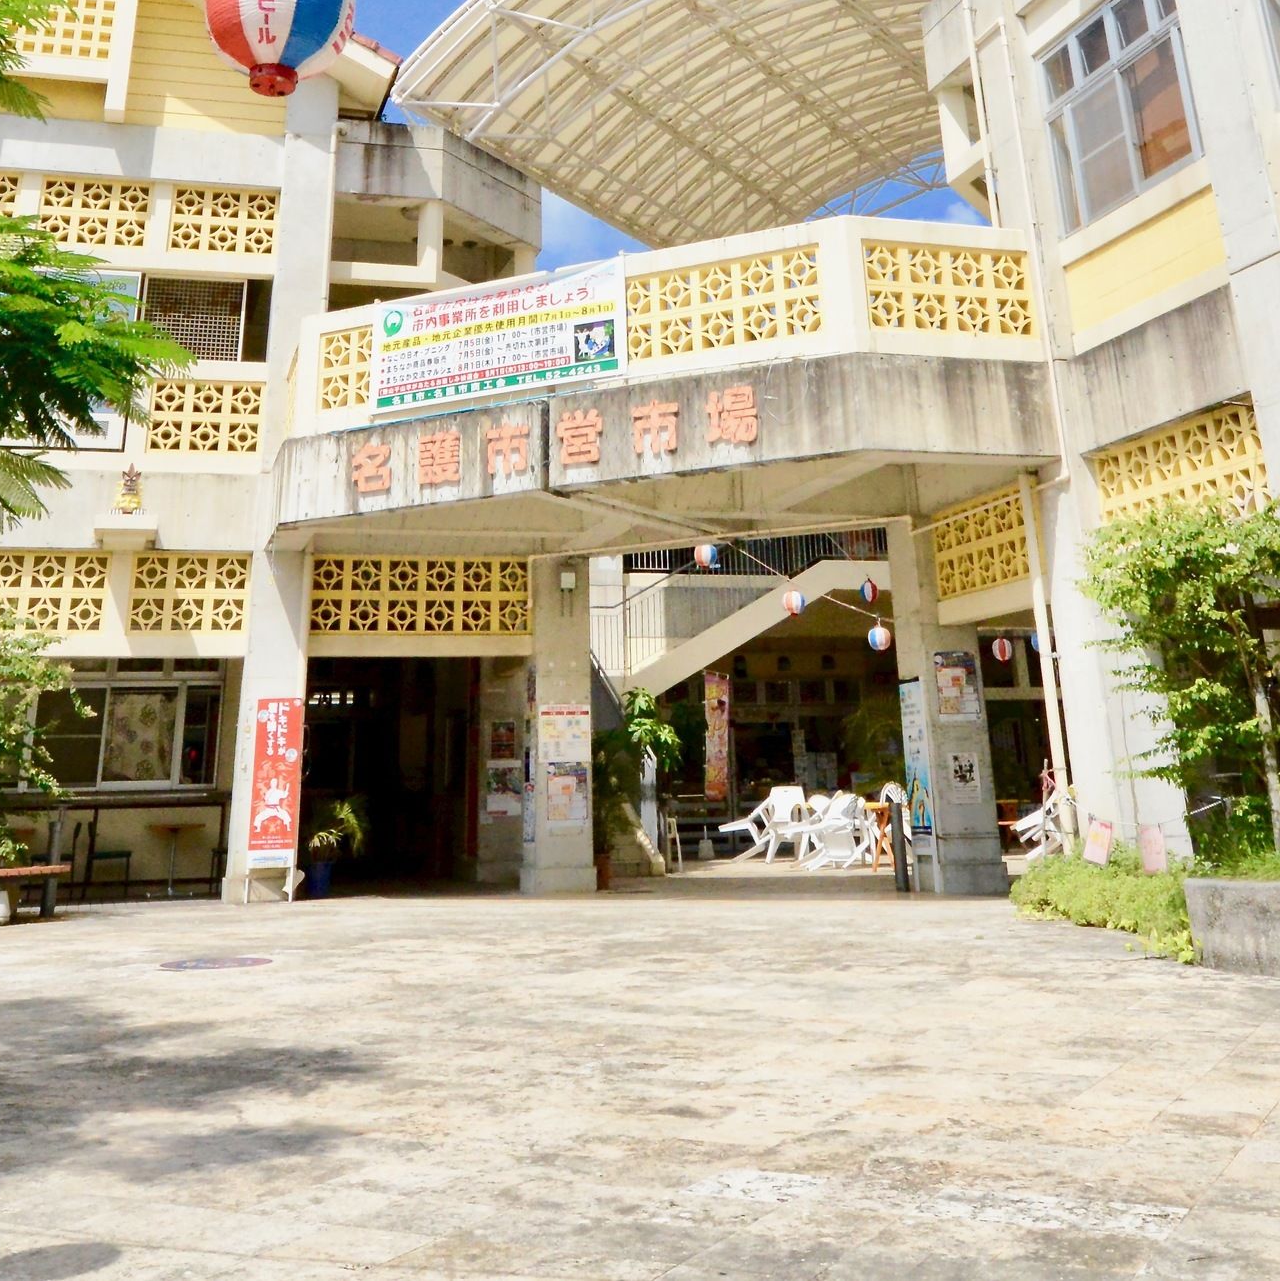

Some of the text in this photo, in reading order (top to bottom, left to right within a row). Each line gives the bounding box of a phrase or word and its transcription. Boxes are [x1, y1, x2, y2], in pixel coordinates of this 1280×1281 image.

[351, 385, 760, 493] 名護市営市場
